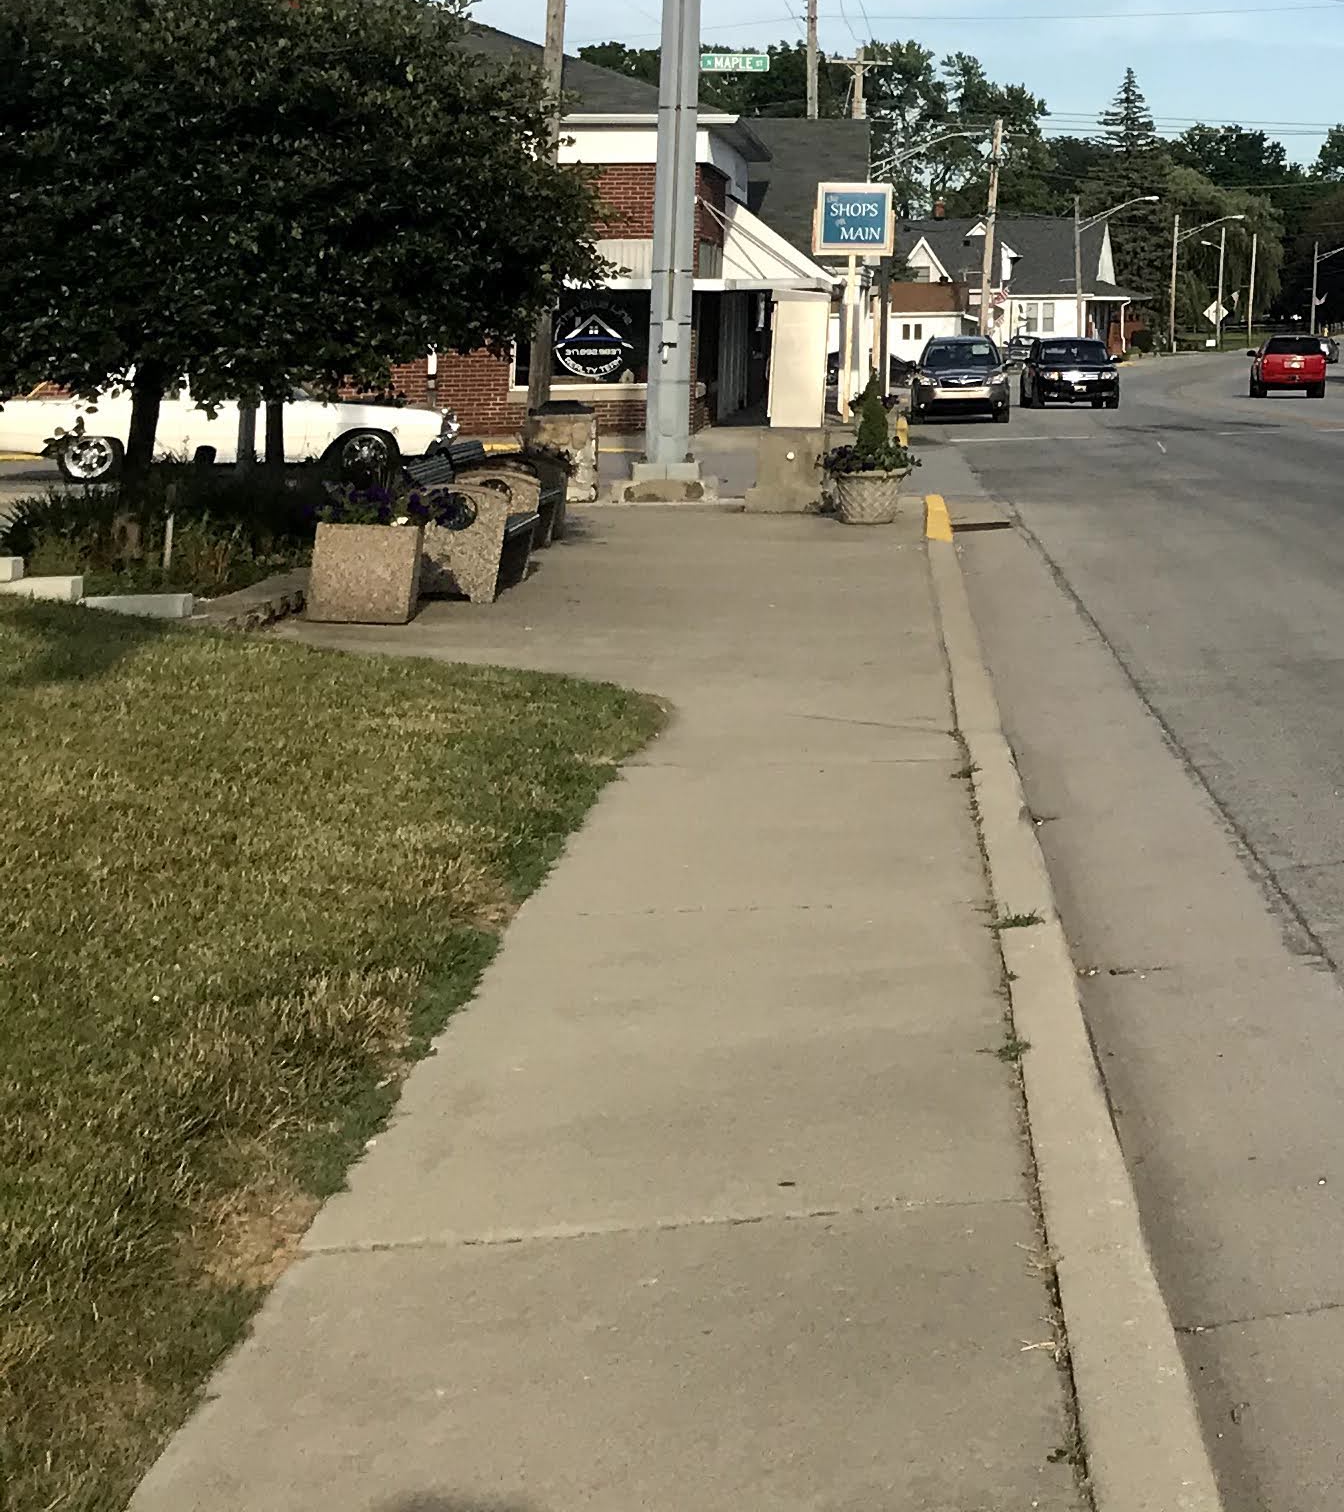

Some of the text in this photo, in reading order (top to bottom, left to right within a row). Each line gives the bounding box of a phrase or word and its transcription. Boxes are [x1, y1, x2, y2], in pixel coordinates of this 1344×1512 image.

[714, 56, 753, 69] MAPLE
[755, 59, 763, 67] ST
[830, 202, 879, 217] SHOPS
[840, 226, 882, 240] MAIN
